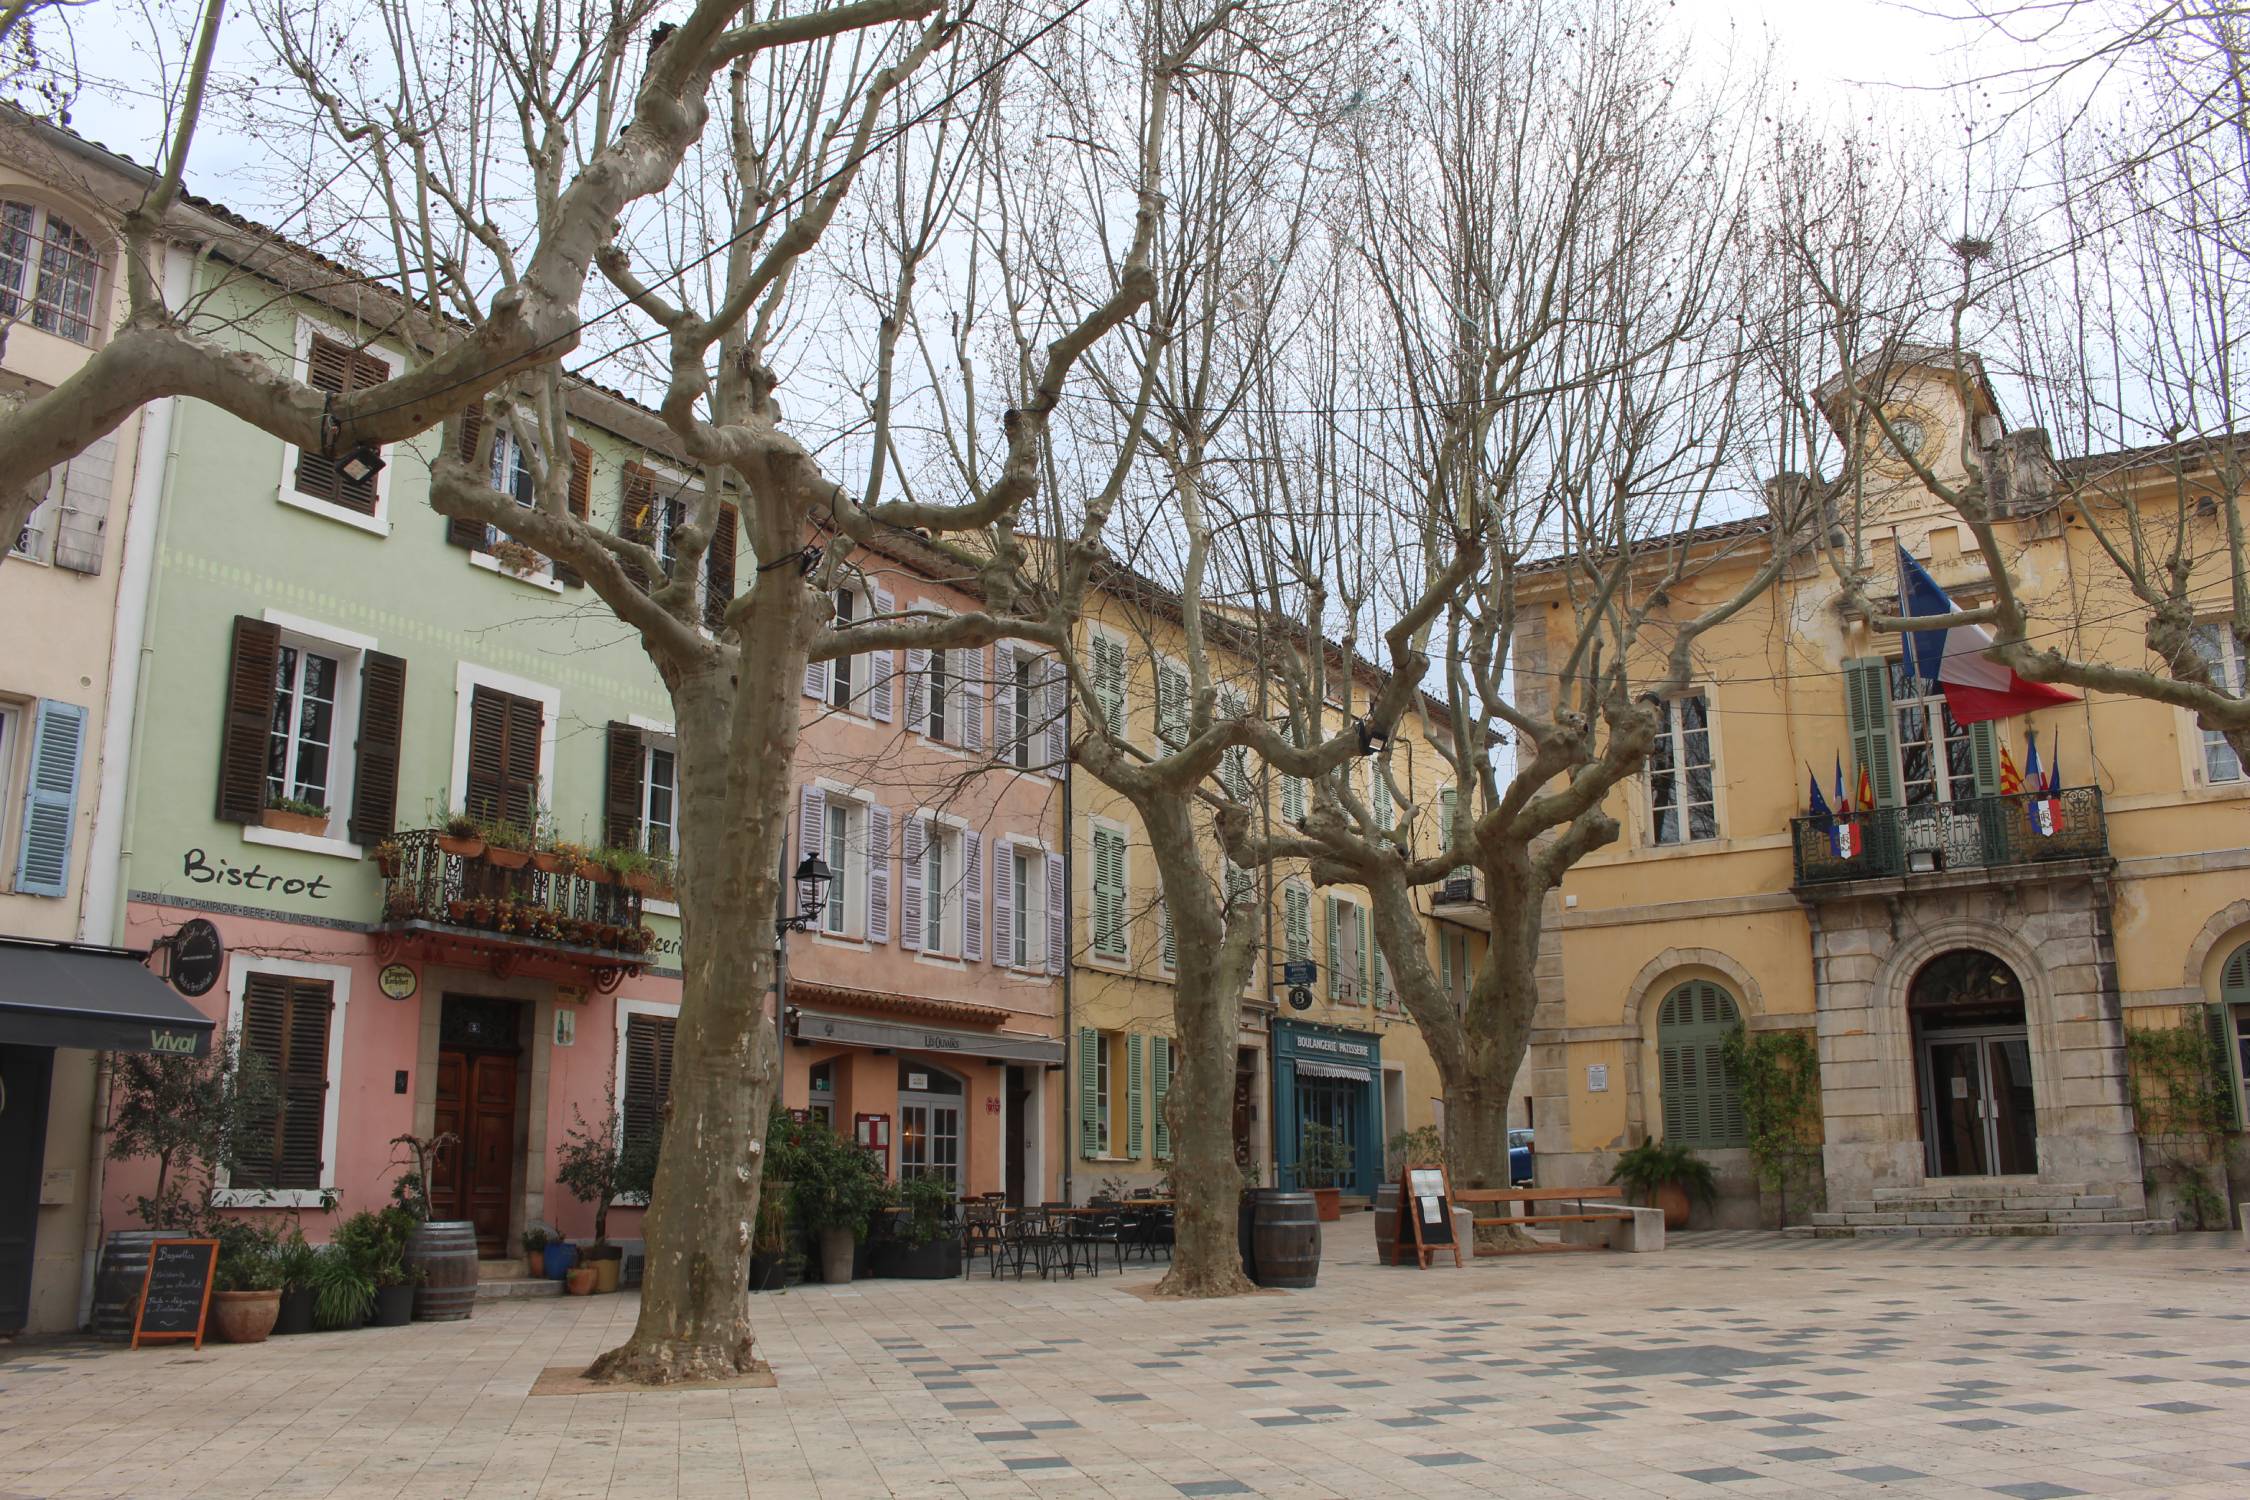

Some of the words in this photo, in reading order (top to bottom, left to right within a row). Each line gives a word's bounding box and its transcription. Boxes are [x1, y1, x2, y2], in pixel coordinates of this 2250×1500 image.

[183, 848, 333, 899] Bistrot
[141, 891, 158, 902] BAR
[190, 899, 238, 914] CHAMPAGNE
[271, 910, 286, 921] EAU
[152, 1030, 198, 1053] Vival
[1297, 1036, 1338, 1052] BOULANGERIE
[1339, 1043, 1369, 1057] PATISSERIE
